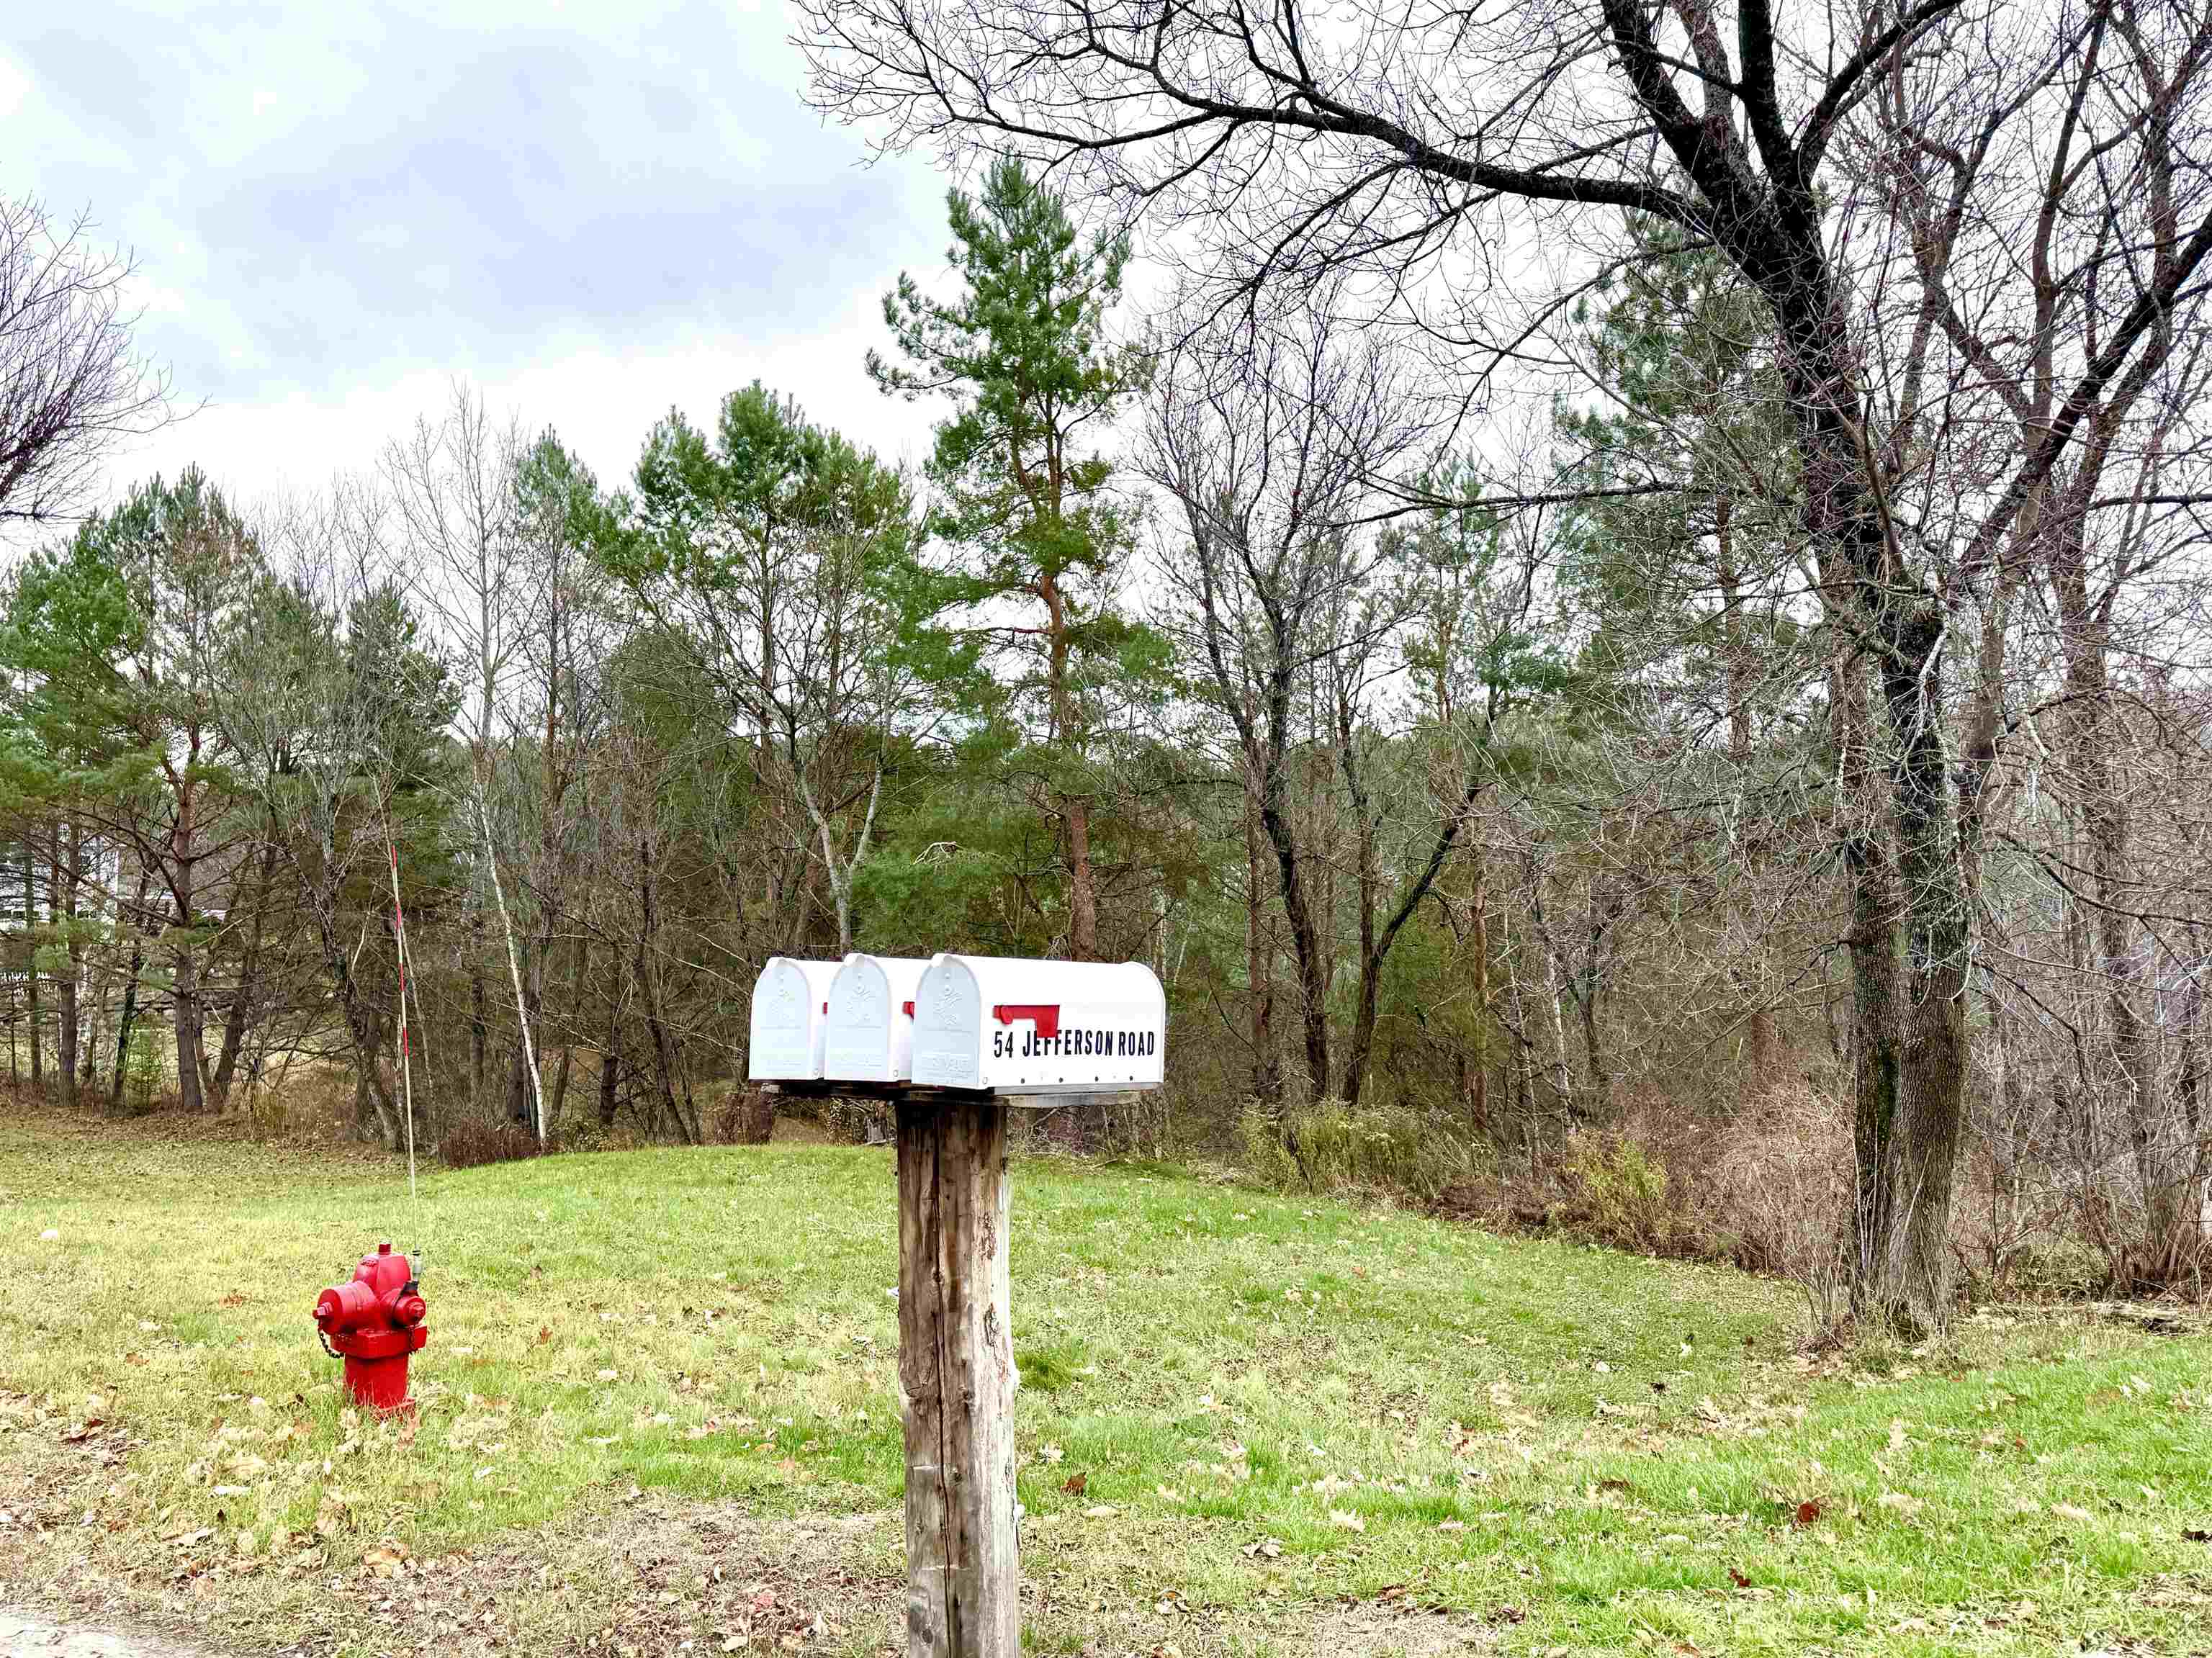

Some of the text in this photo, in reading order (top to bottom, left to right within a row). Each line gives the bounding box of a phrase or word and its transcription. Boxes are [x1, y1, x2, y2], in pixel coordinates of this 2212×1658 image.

[994, 1030, 1154, 1058] 54 JEFFERSON ROAD
